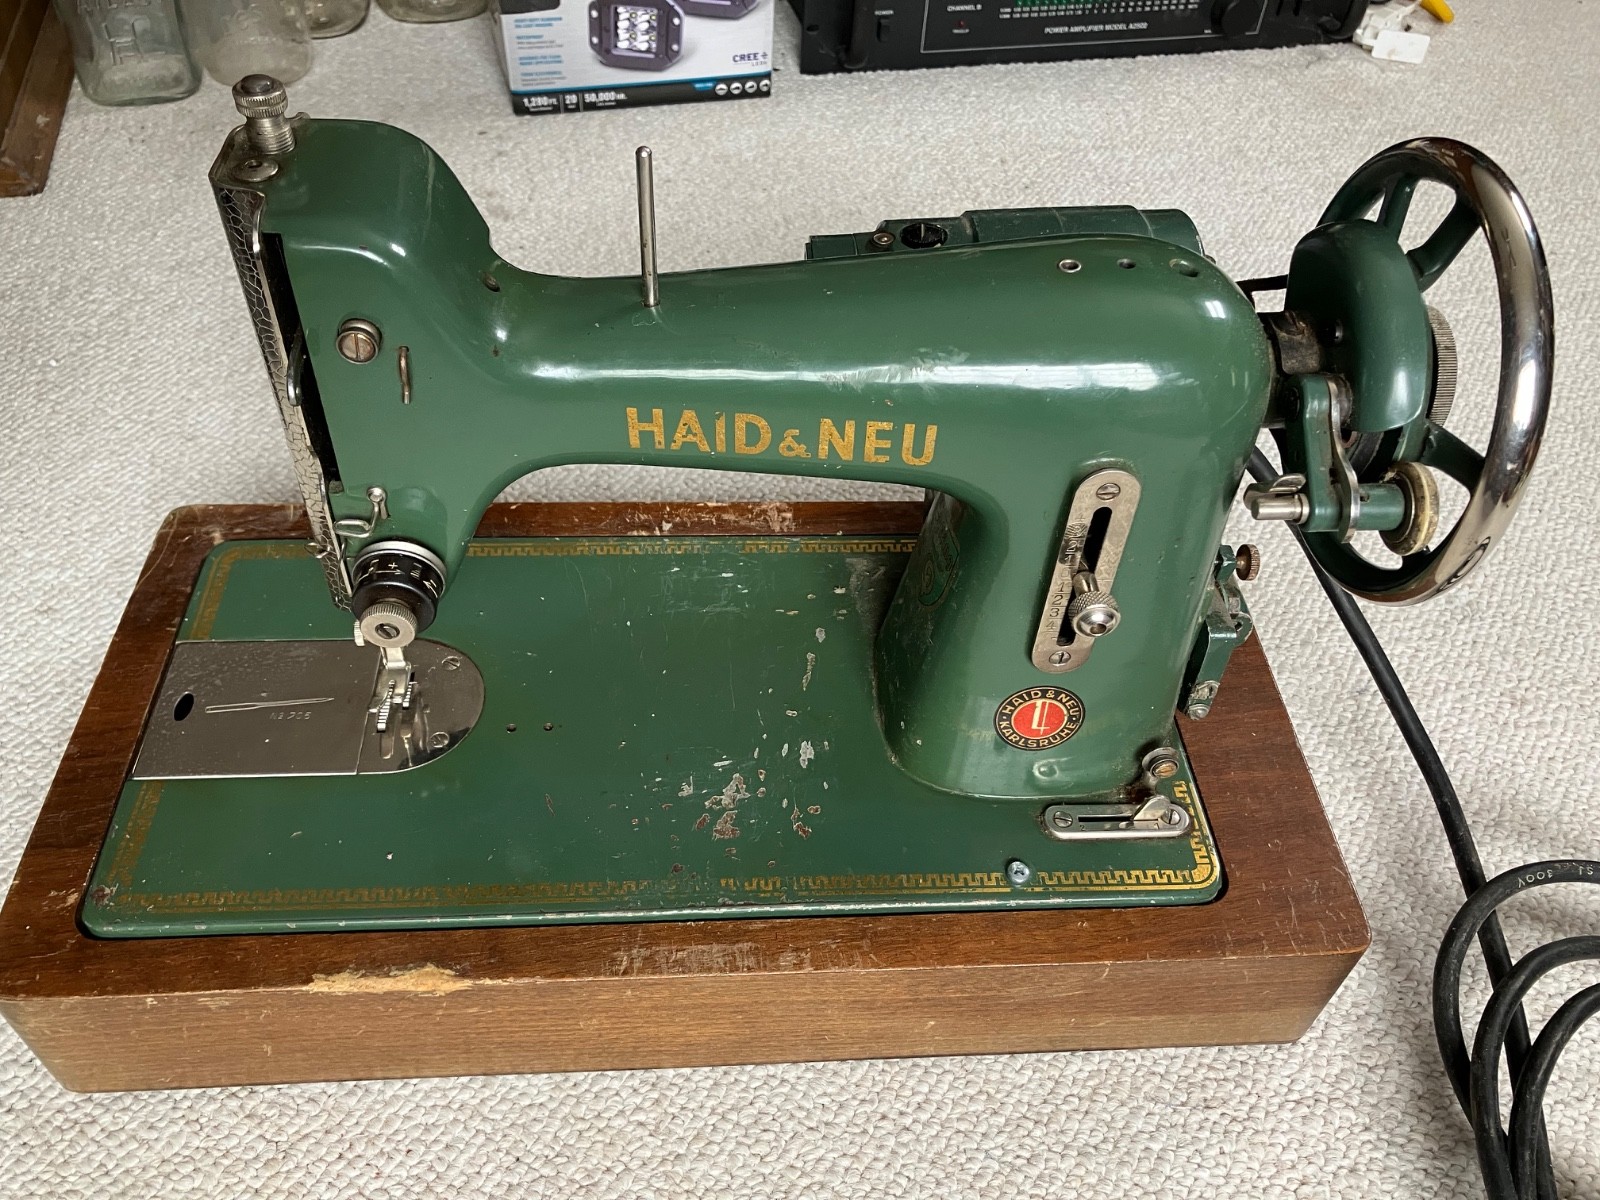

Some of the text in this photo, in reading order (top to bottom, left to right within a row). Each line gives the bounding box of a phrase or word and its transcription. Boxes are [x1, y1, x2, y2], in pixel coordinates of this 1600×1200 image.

[1044, 26, 1069, 34] POWER
[1069, 24, 1104, 32] AMPLIFIER
[732, 53, 759, 62] CREE
[626, 407, 938, 466] HAID & NEU
[1057, 582, 1065, 592] 1
[1052, 595, 1064, 605] 2
[1050, 608, 1060, 617] 3
[1002, 690, 1080, 716] HAID & NEU
[999, 721, 1077, 748] KARLSRUHE
[1517, 869, 1554, 889] 300V
